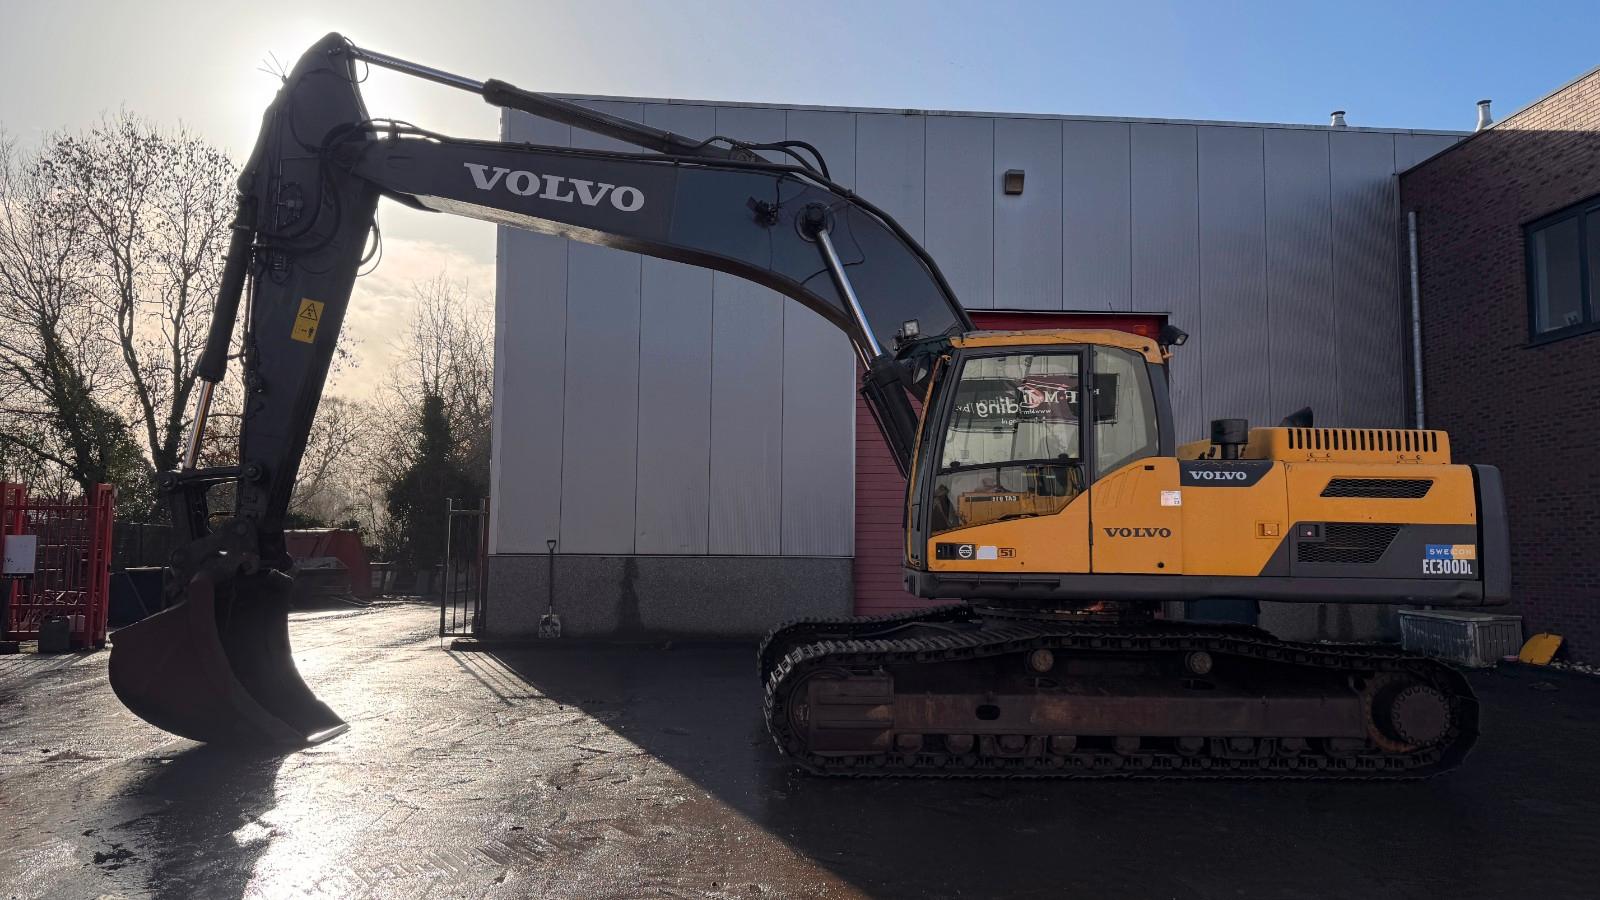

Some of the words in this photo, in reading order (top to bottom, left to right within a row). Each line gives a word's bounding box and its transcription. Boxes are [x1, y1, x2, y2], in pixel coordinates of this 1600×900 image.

[463, 162, 645, 212] VOLVO
[1188, 471, 1247, 482] VOLVO
[1104, 527, 1172, 538] VOLVO
[1429, 548, 1473, 556] SWECON
